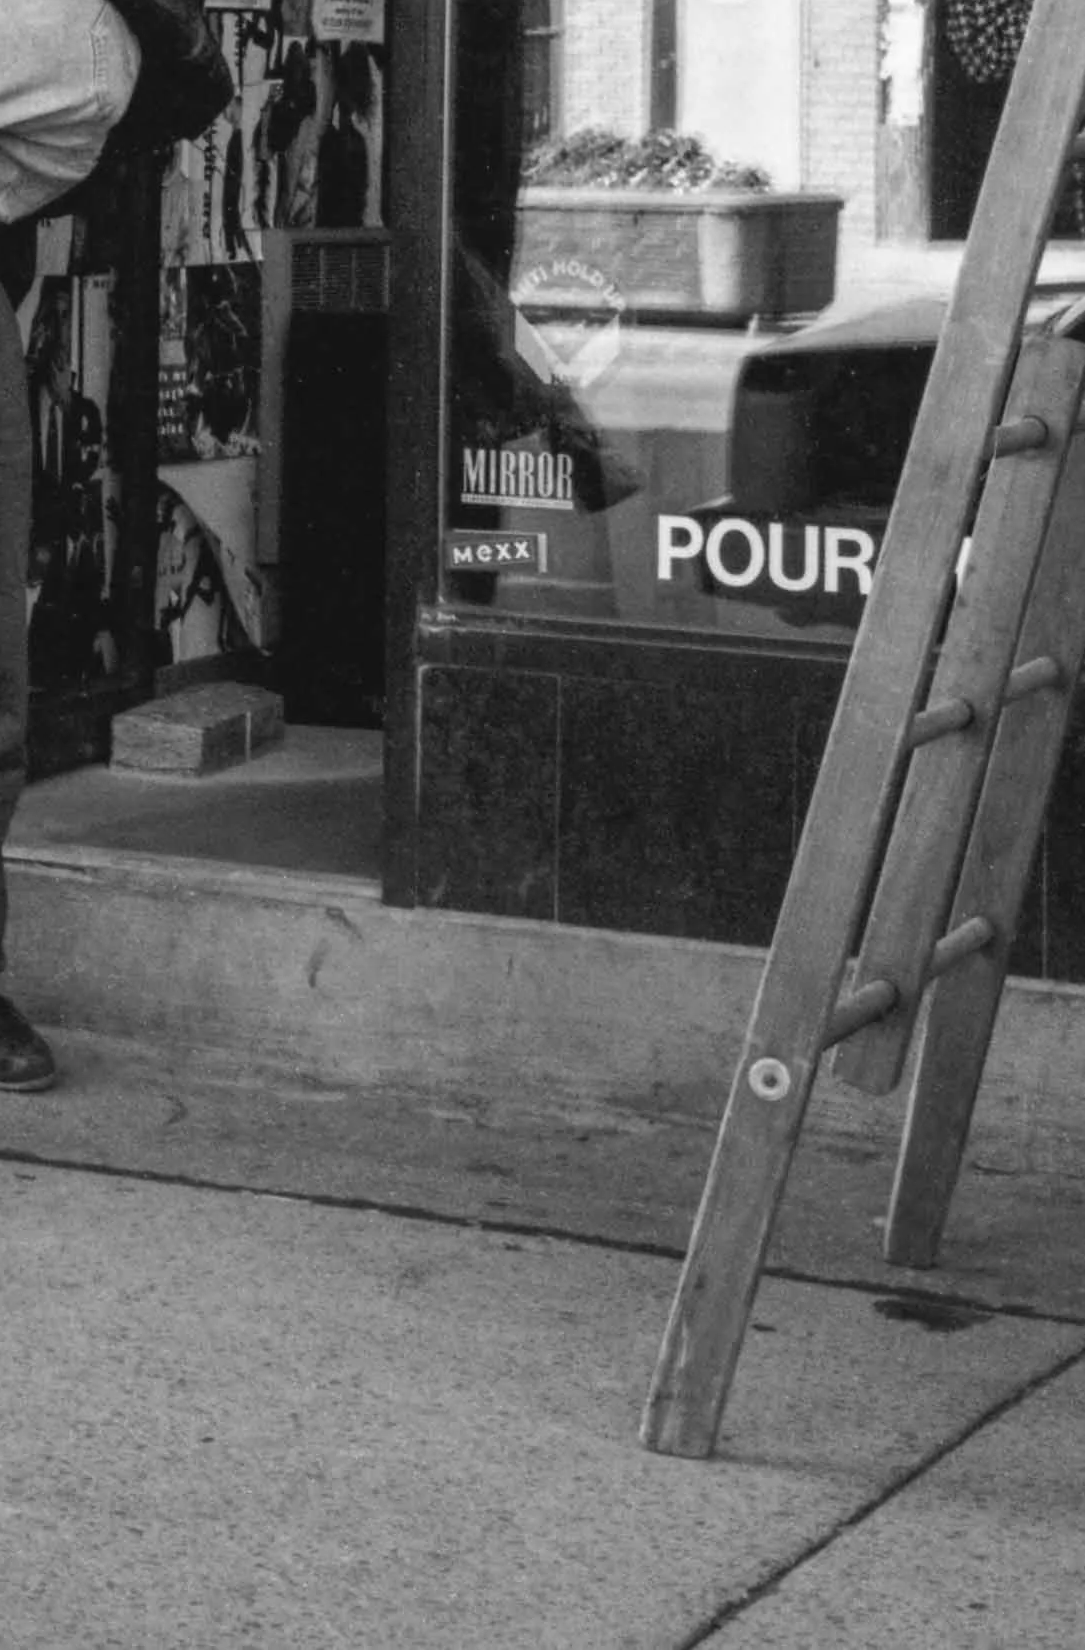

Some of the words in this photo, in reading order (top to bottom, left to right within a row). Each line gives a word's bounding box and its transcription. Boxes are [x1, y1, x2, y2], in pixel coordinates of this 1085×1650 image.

[552, 260, 604, 287] HOLD
[463, 447, 573, 499] MIRROR
[658, 514, 875, 596] POUR
